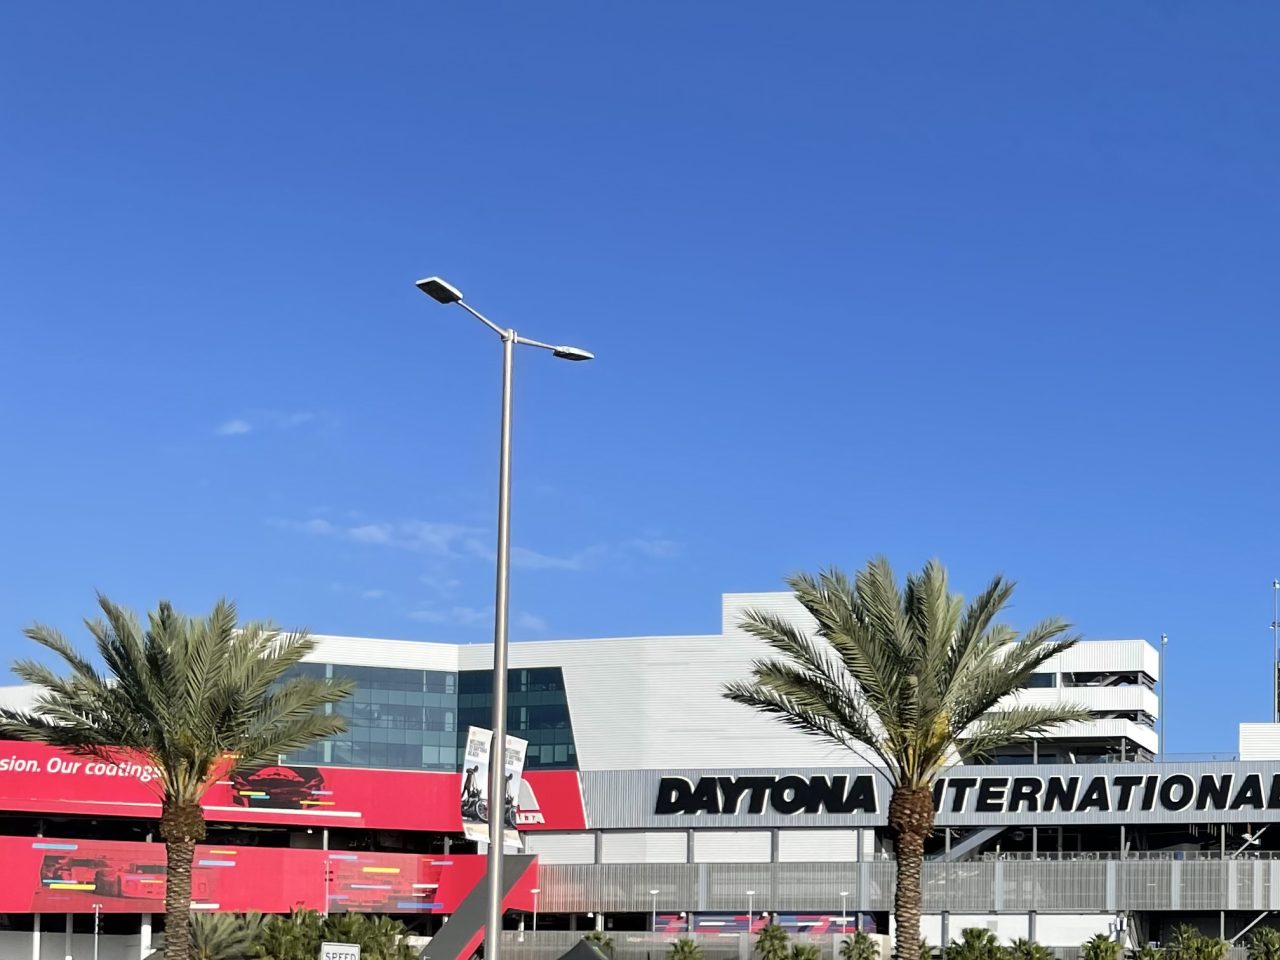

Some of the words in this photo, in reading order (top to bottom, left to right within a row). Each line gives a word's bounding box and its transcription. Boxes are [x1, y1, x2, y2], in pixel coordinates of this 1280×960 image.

[47, 757, 82, 775] Our
[85, 762, 162, 782] coatings
[655, 775, 880, 815] DAYTONA
